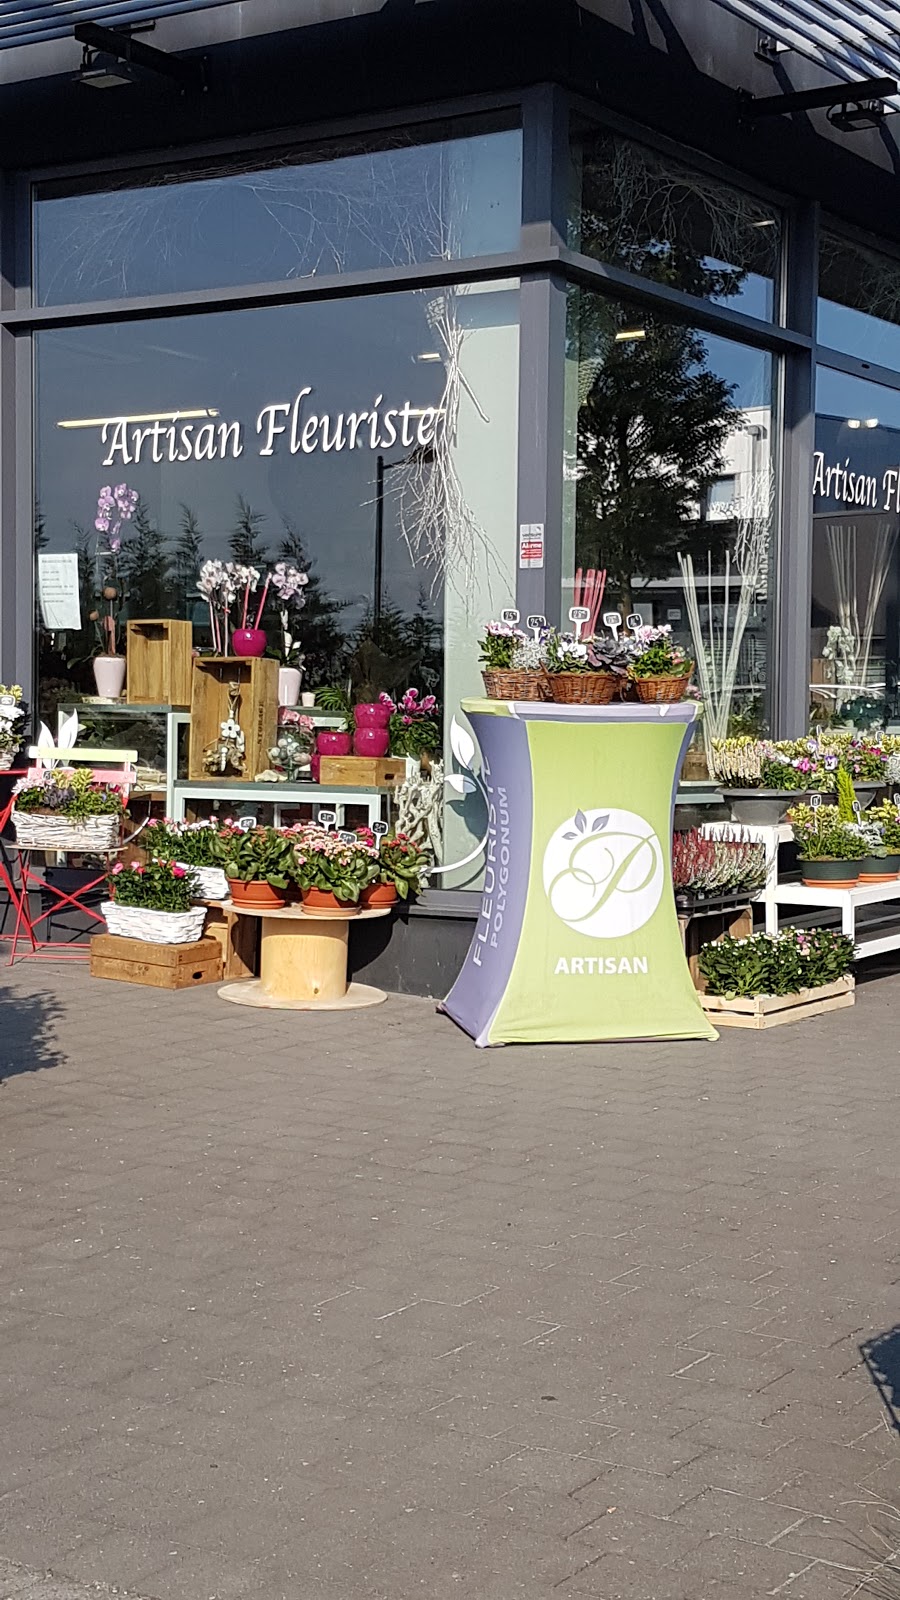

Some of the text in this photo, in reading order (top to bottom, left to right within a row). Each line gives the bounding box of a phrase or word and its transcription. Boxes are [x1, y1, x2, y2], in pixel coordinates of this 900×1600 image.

[102, 387, 436, 466] Artisan Fleuriste
[812, 451, 877, 508] Artisan
[490, 786, 510, 948] POLYGONUM
[554, 955, 649, 976] ARTISAN
